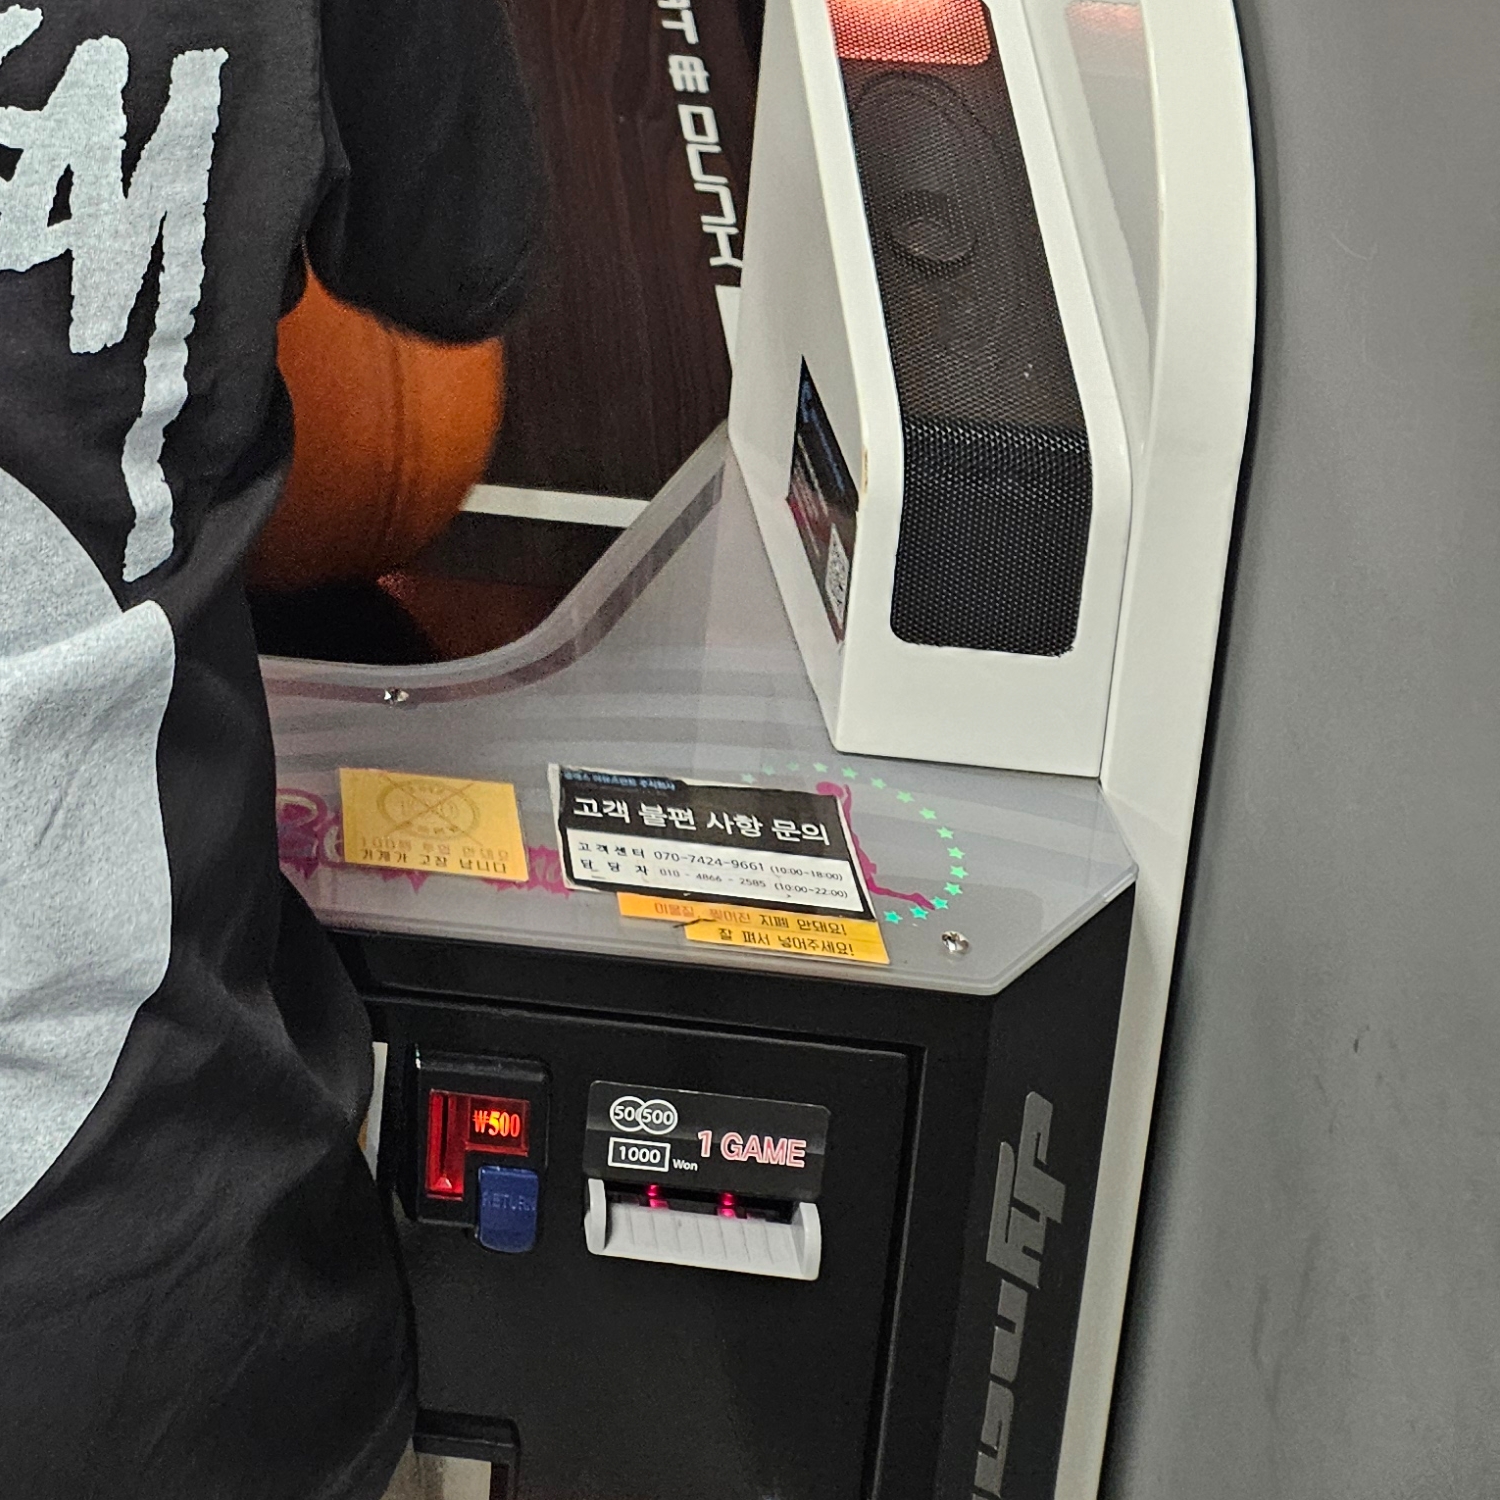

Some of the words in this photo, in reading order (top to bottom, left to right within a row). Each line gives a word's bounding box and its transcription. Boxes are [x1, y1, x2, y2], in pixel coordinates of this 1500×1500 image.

[676, 103, 744, 268] DUNK
[573, 796, 631, 825] 고객
[638, 802, 698, 831] 불편
[706, 810, 764, 839] 사항
[771, 818, 831, 846] 문의
[578, 841, 646, 860] 고객센터
[653, 850, 765, 872] 070-7424-9661
[760, 913, 790, 930] 지폐
[718, 927, 733, 941] 잘
[777, 936, 854, 957] 넣어주세요!
[472, 1110, 522, 1139] ₩500
[642, 1108, 674, 1126] 500
[618, 1145, 661, 1164] 1000
[672, 1158, 699, 1172] Won
[697, 1130, 713, 1158] 1
[720, 1131, 807, 1168] GAME
